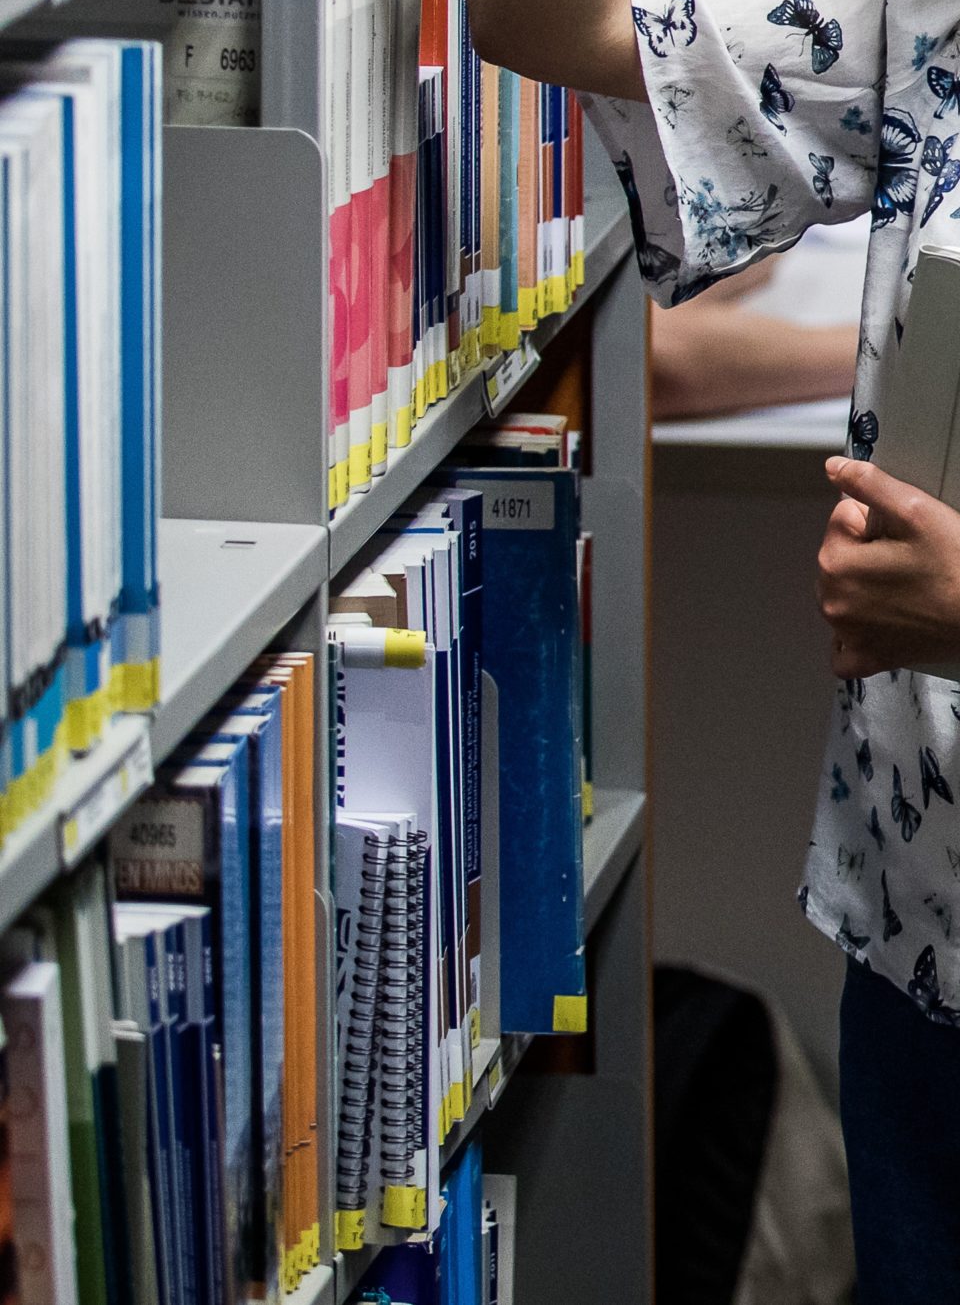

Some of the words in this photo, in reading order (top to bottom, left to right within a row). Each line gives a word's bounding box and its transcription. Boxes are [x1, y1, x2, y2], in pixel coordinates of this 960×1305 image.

[185, 44, 195, 68] F
[492, 496, 532, 519] 41871
[469, 520, 477, 561] 2015
